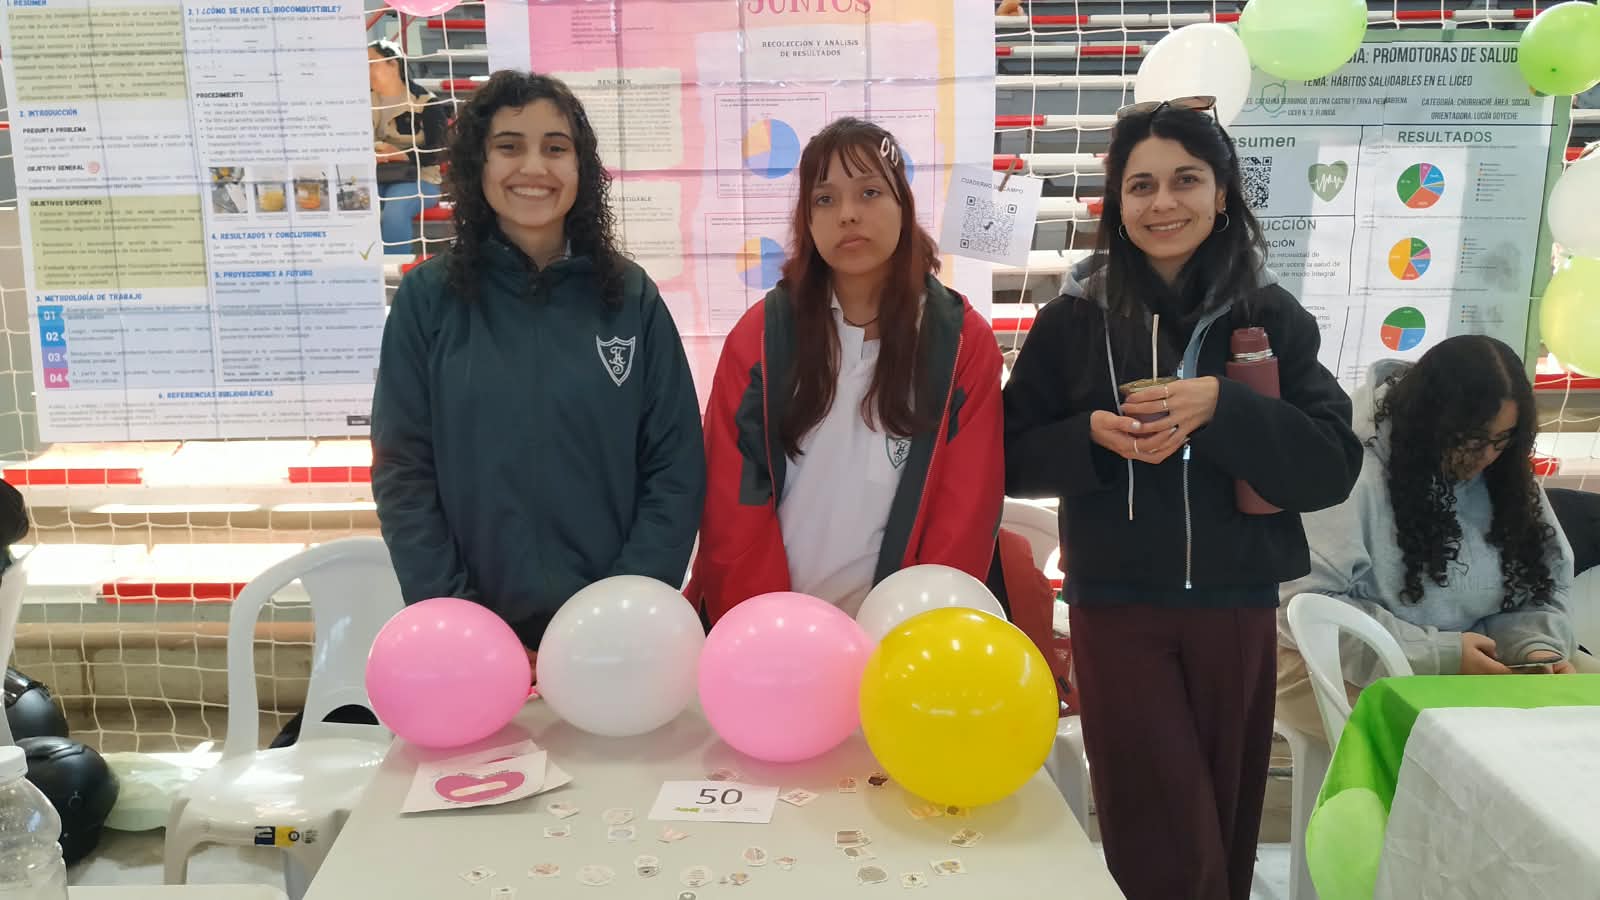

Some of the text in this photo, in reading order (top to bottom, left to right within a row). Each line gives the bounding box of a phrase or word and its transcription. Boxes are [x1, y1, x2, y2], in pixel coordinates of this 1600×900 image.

[1373, 46, 1457, 64] PROMOTORAS
[1461, 46, 1476, 63] DE
[1480, 47, 1518, 63] SALUD
[1331, 74, 1366, 87] HÁBITOS
[1368, 75, 1422, 87] SALUDABLES
[1424, 75, 1435, 86] EN
[1437, 75, 1448, 86] EL
[1449, 75, 1472, 86] LICEO
[1511, 97, 1530, 106] SOCIAL
[28, 109, 78, 117] INTRODUCCIÓN
[1229, 136, 1295, 148] esumen
[1398, 131, 1493, 143] RESULTADOS
[961, 177, 992, 189] CUADERNO
[1262, 217, 1316, 231] UCCIÓN
[1266, 238, 1295, 248] ACIÓN
[286, 269, 313, 277] FUTURO
[1312, 271, 1336, 279] integral
[45, 291, 94, 302] METODOLOGÍA
[110, 293, 142, 301] TRABAJO
[44, 311, 56, 321] 01
[46, 332, 59, 342] 02
[48, 353, 60, 362] 03
[50, 373, 63, 383] 04
[167, 391, 215, 399] REFERENCIAS
[695, 787, 743, 806] 50
